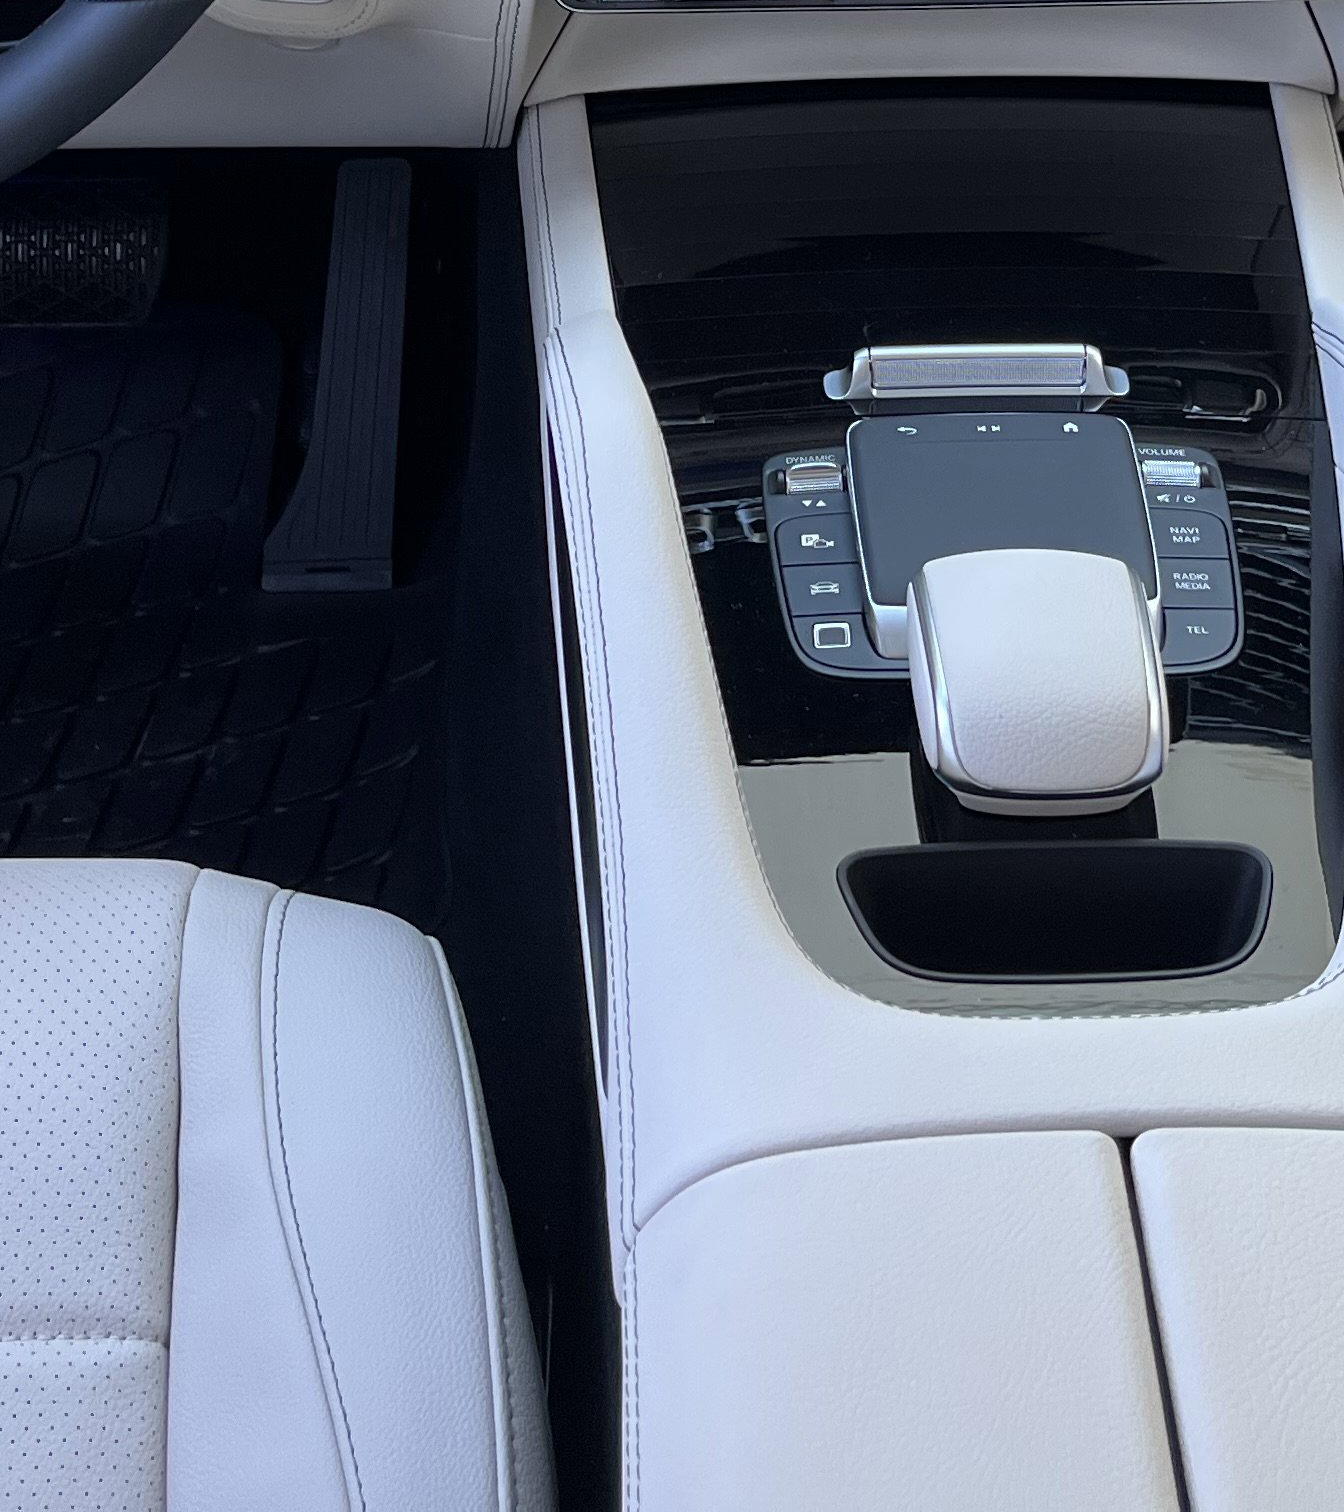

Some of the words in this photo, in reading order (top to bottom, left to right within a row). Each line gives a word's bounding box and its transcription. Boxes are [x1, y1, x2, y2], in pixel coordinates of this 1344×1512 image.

[1137, 448, 1187, 457] VOLUME
[785, 453, 837, 465] DYNAMIC
[1169, 526, 1200, 535] NAVI
[1172, 534, 1201, 544] MAP
[1172, 572, 1210, 581] RADIO
[1175, 581, 1212, 590] MEDIA
[1186, 625, 1210, 635] TEL
